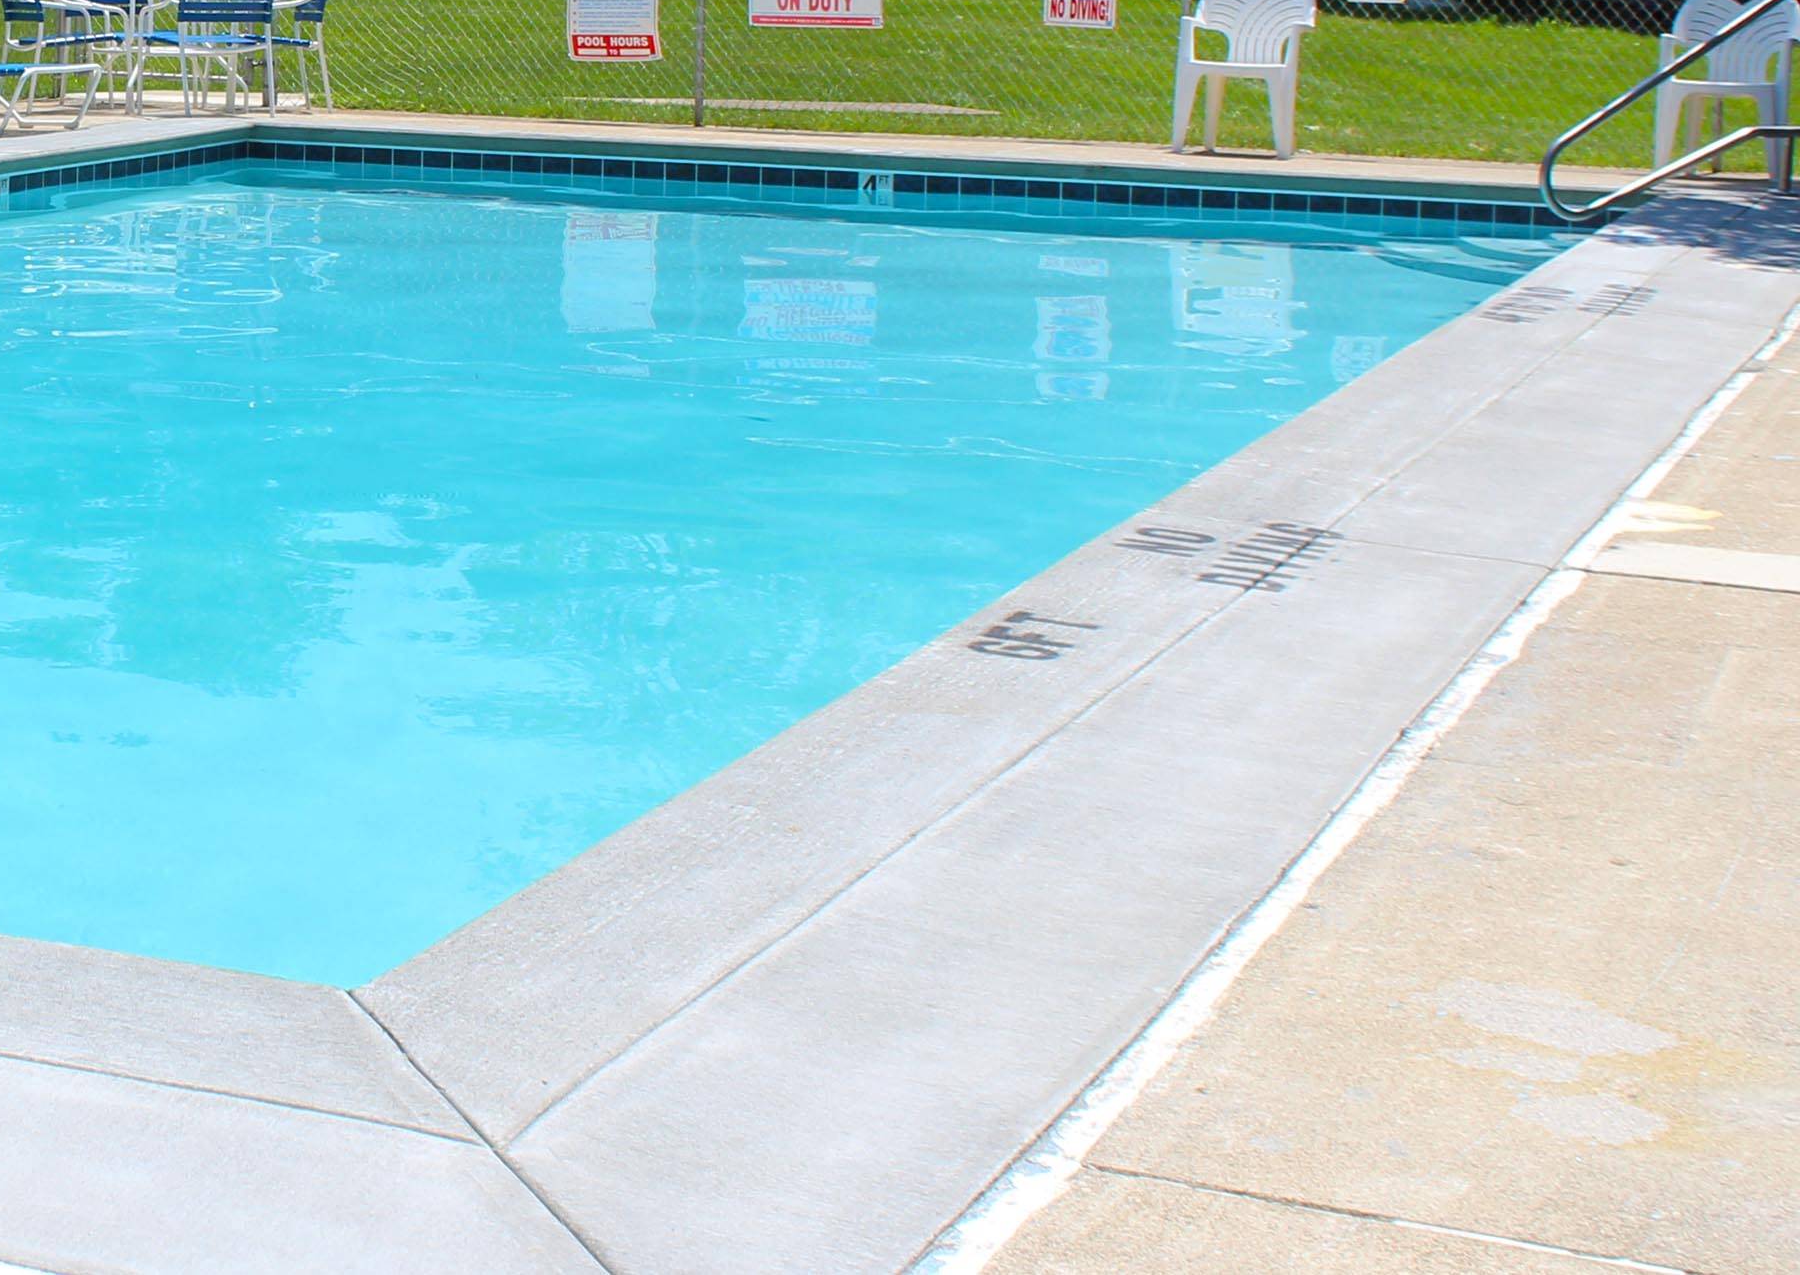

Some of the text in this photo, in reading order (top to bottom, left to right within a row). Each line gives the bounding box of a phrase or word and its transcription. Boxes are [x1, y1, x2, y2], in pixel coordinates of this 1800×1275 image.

[577, 36, 649, 48] POOL HOURS
[1113, 526, 1217, 558] NO
[1193, 521, 1344, 593] DIVING
[967, 610, 1102, 662] 6FT
